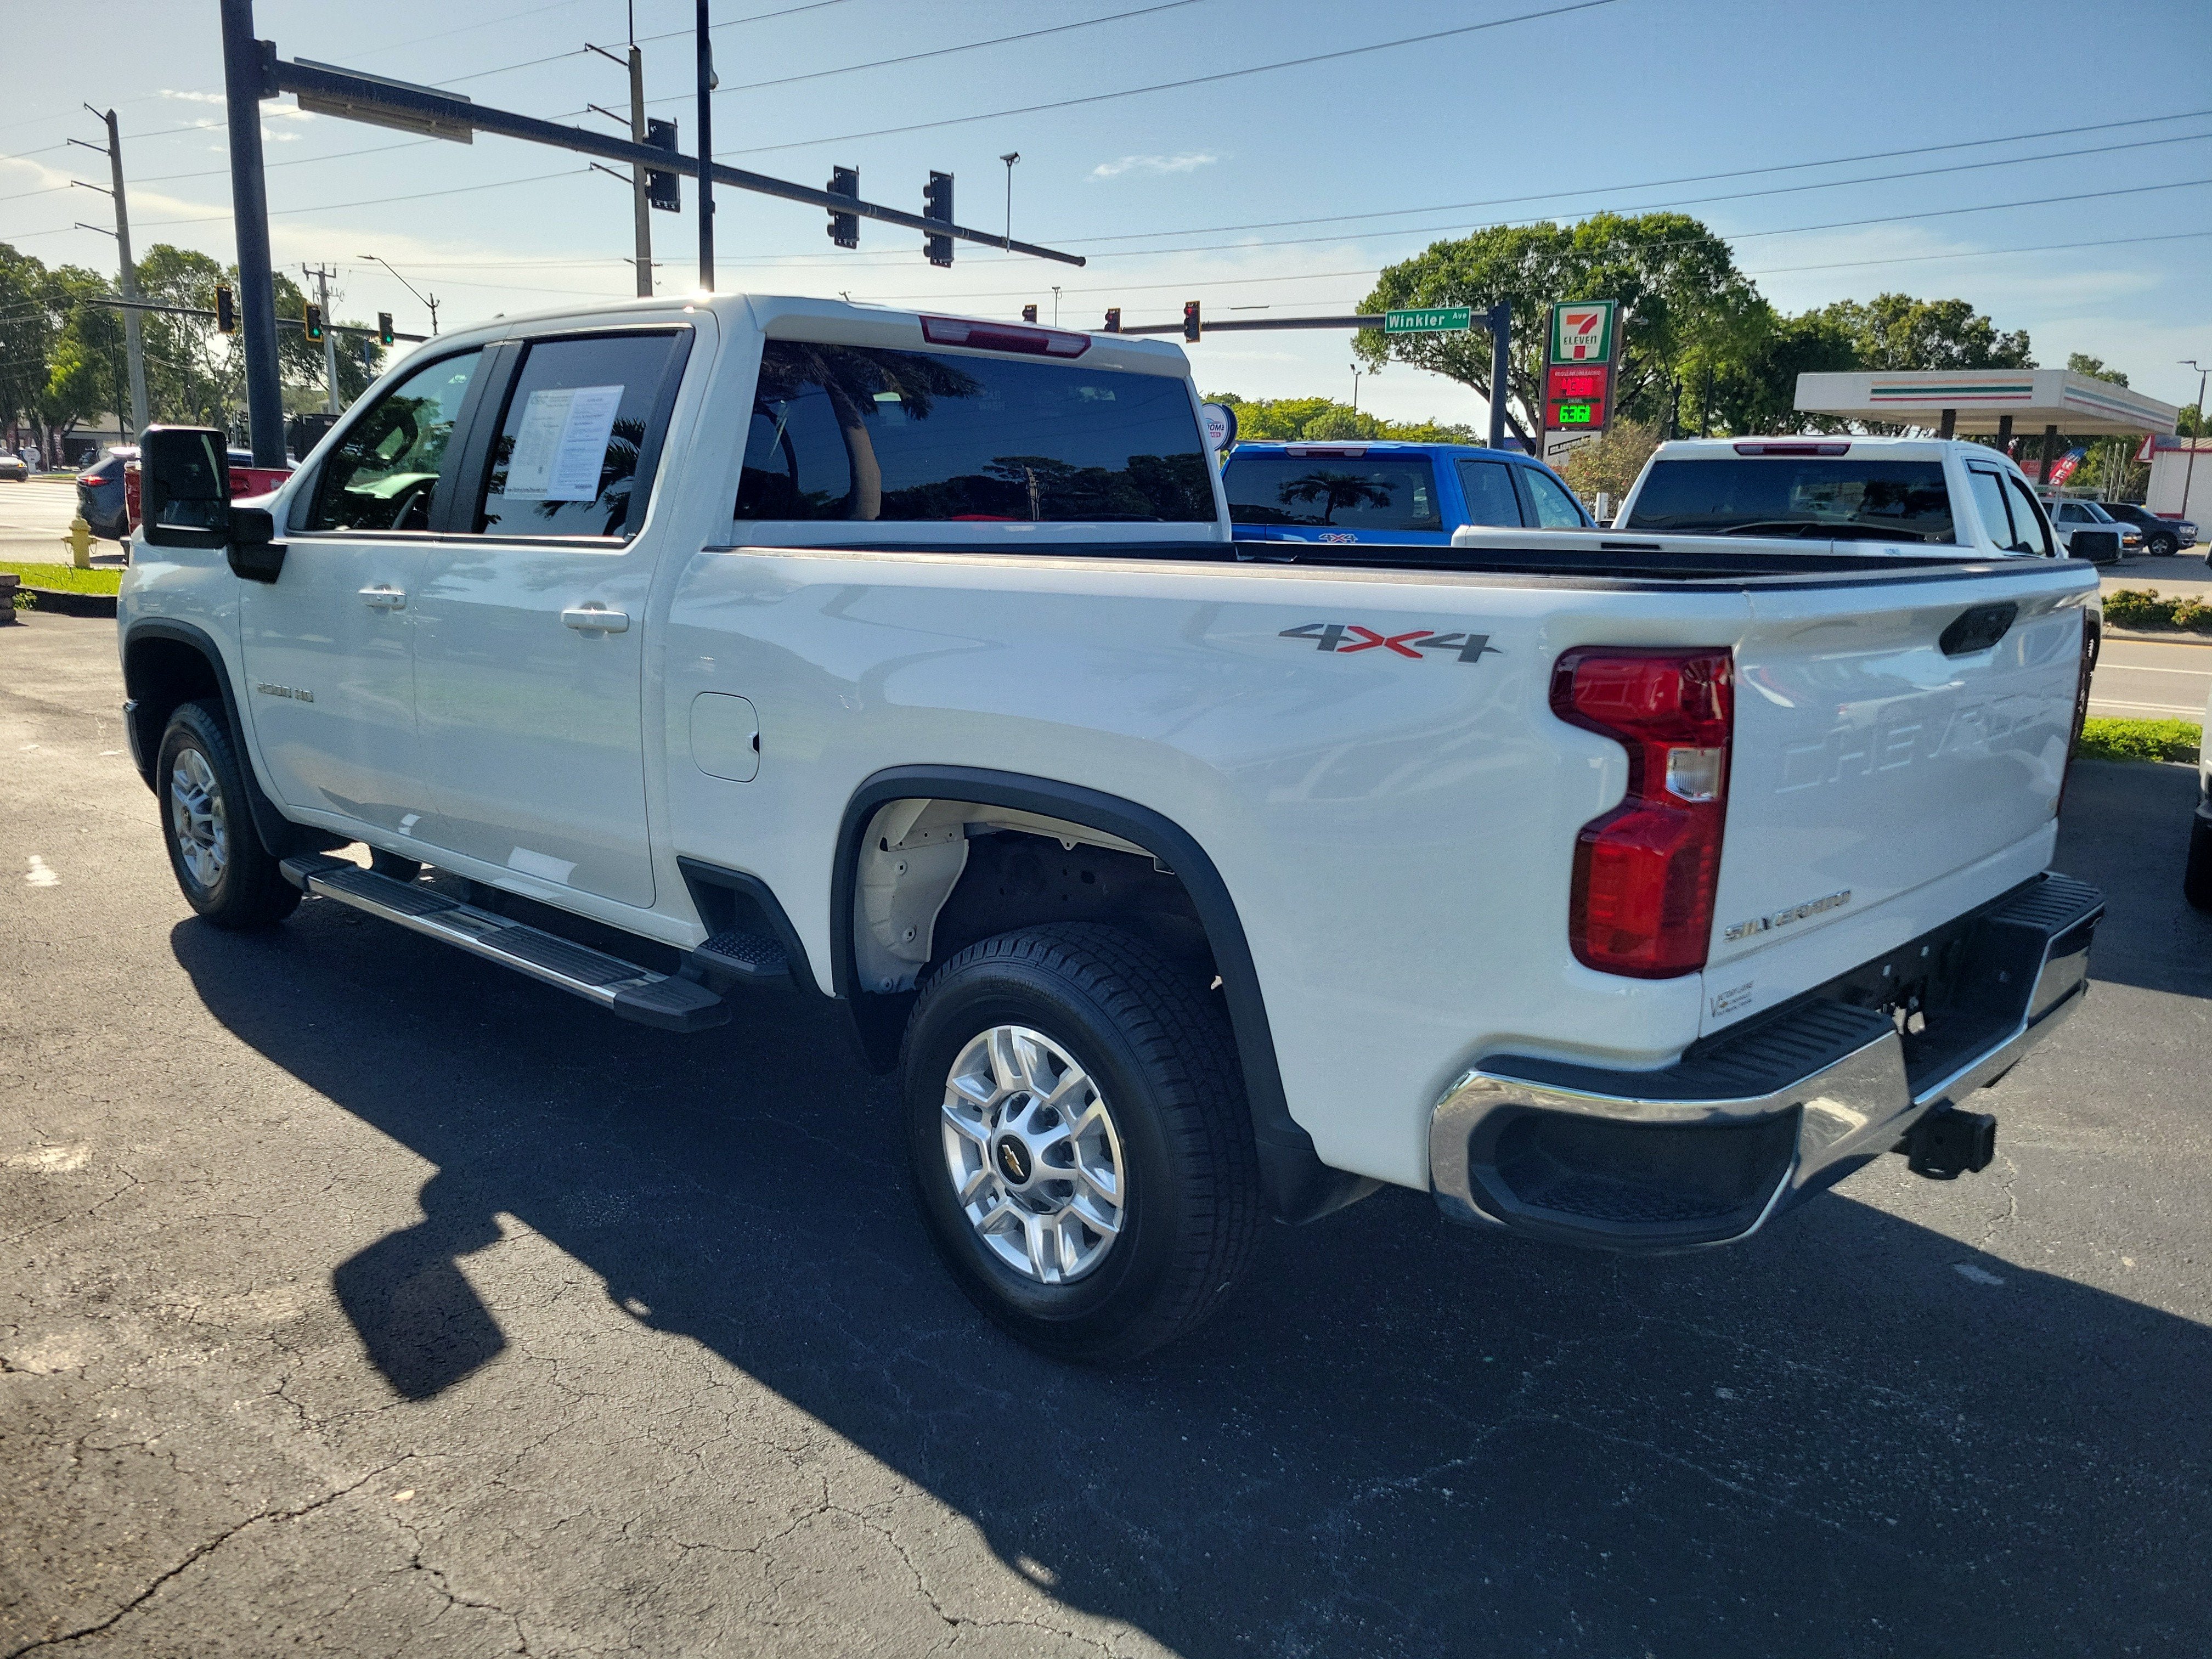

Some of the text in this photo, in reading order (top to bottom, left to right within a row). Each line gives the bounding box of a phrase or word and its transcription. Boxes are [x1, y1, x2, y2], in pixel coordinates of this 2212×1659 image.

[1389, 312, 1467, 329] Winkler Ave
[1566, 313, 1598, 359] 7
[1278, 623, 1503, 663] 4X4
[1723, 889, 1851, 943] SILVERADO
